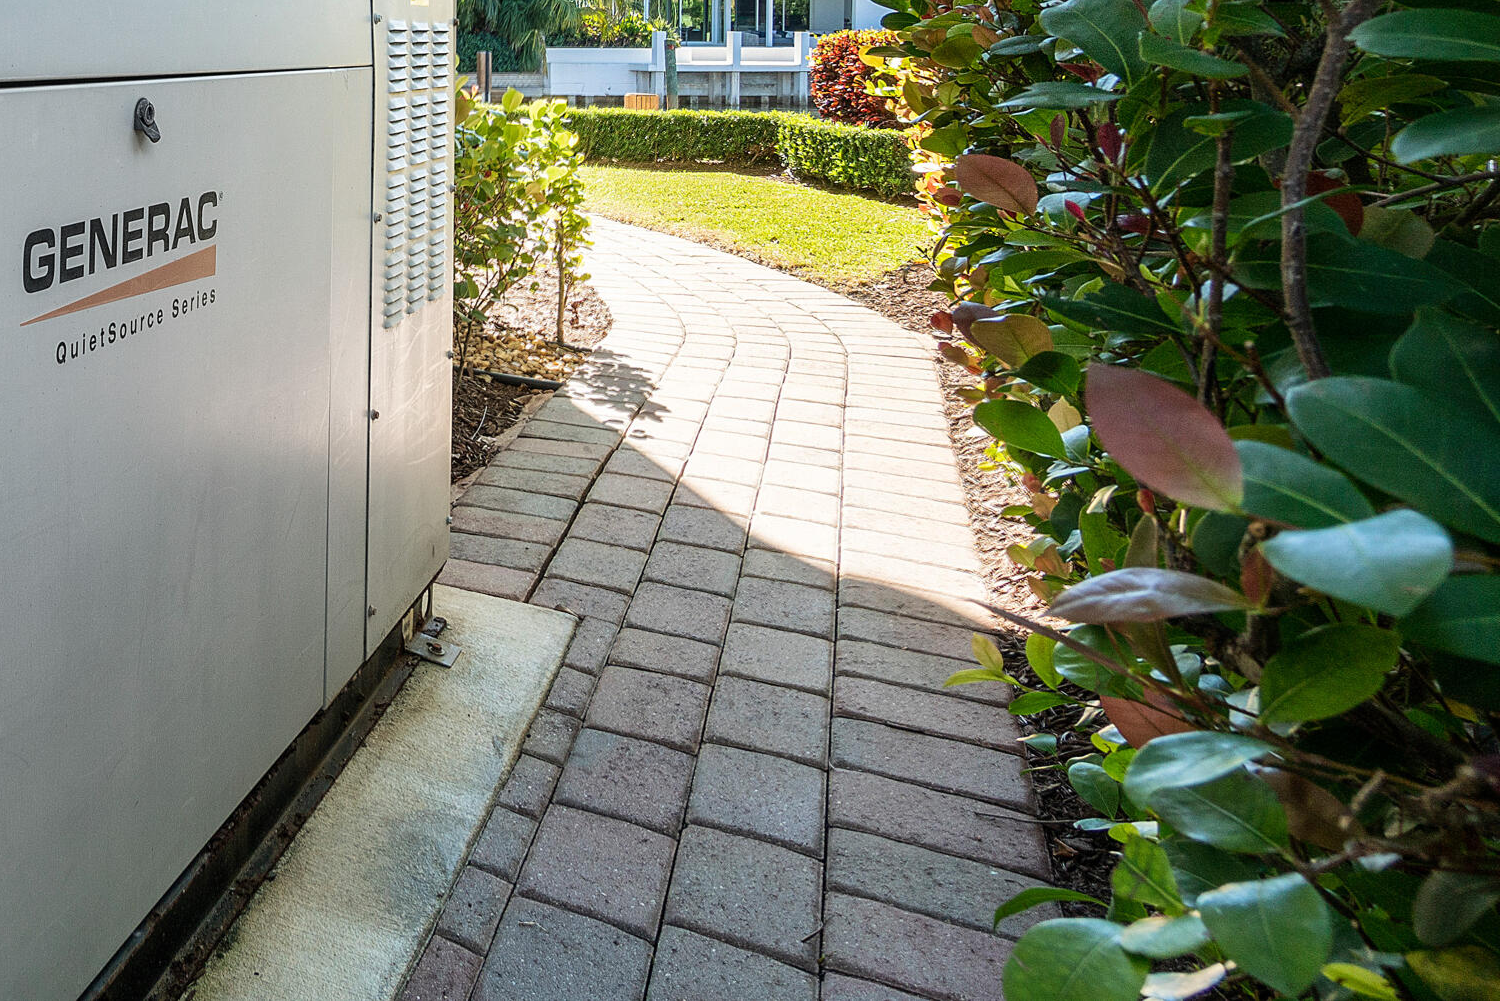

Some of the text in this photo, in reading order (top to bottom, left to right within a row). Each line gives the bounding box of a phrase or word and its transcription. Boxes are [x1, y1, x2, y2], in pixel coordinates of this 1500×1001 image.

[22, 190, 218, 294] GENERAC
[55, 288, 216, 365] QuietSource Series
